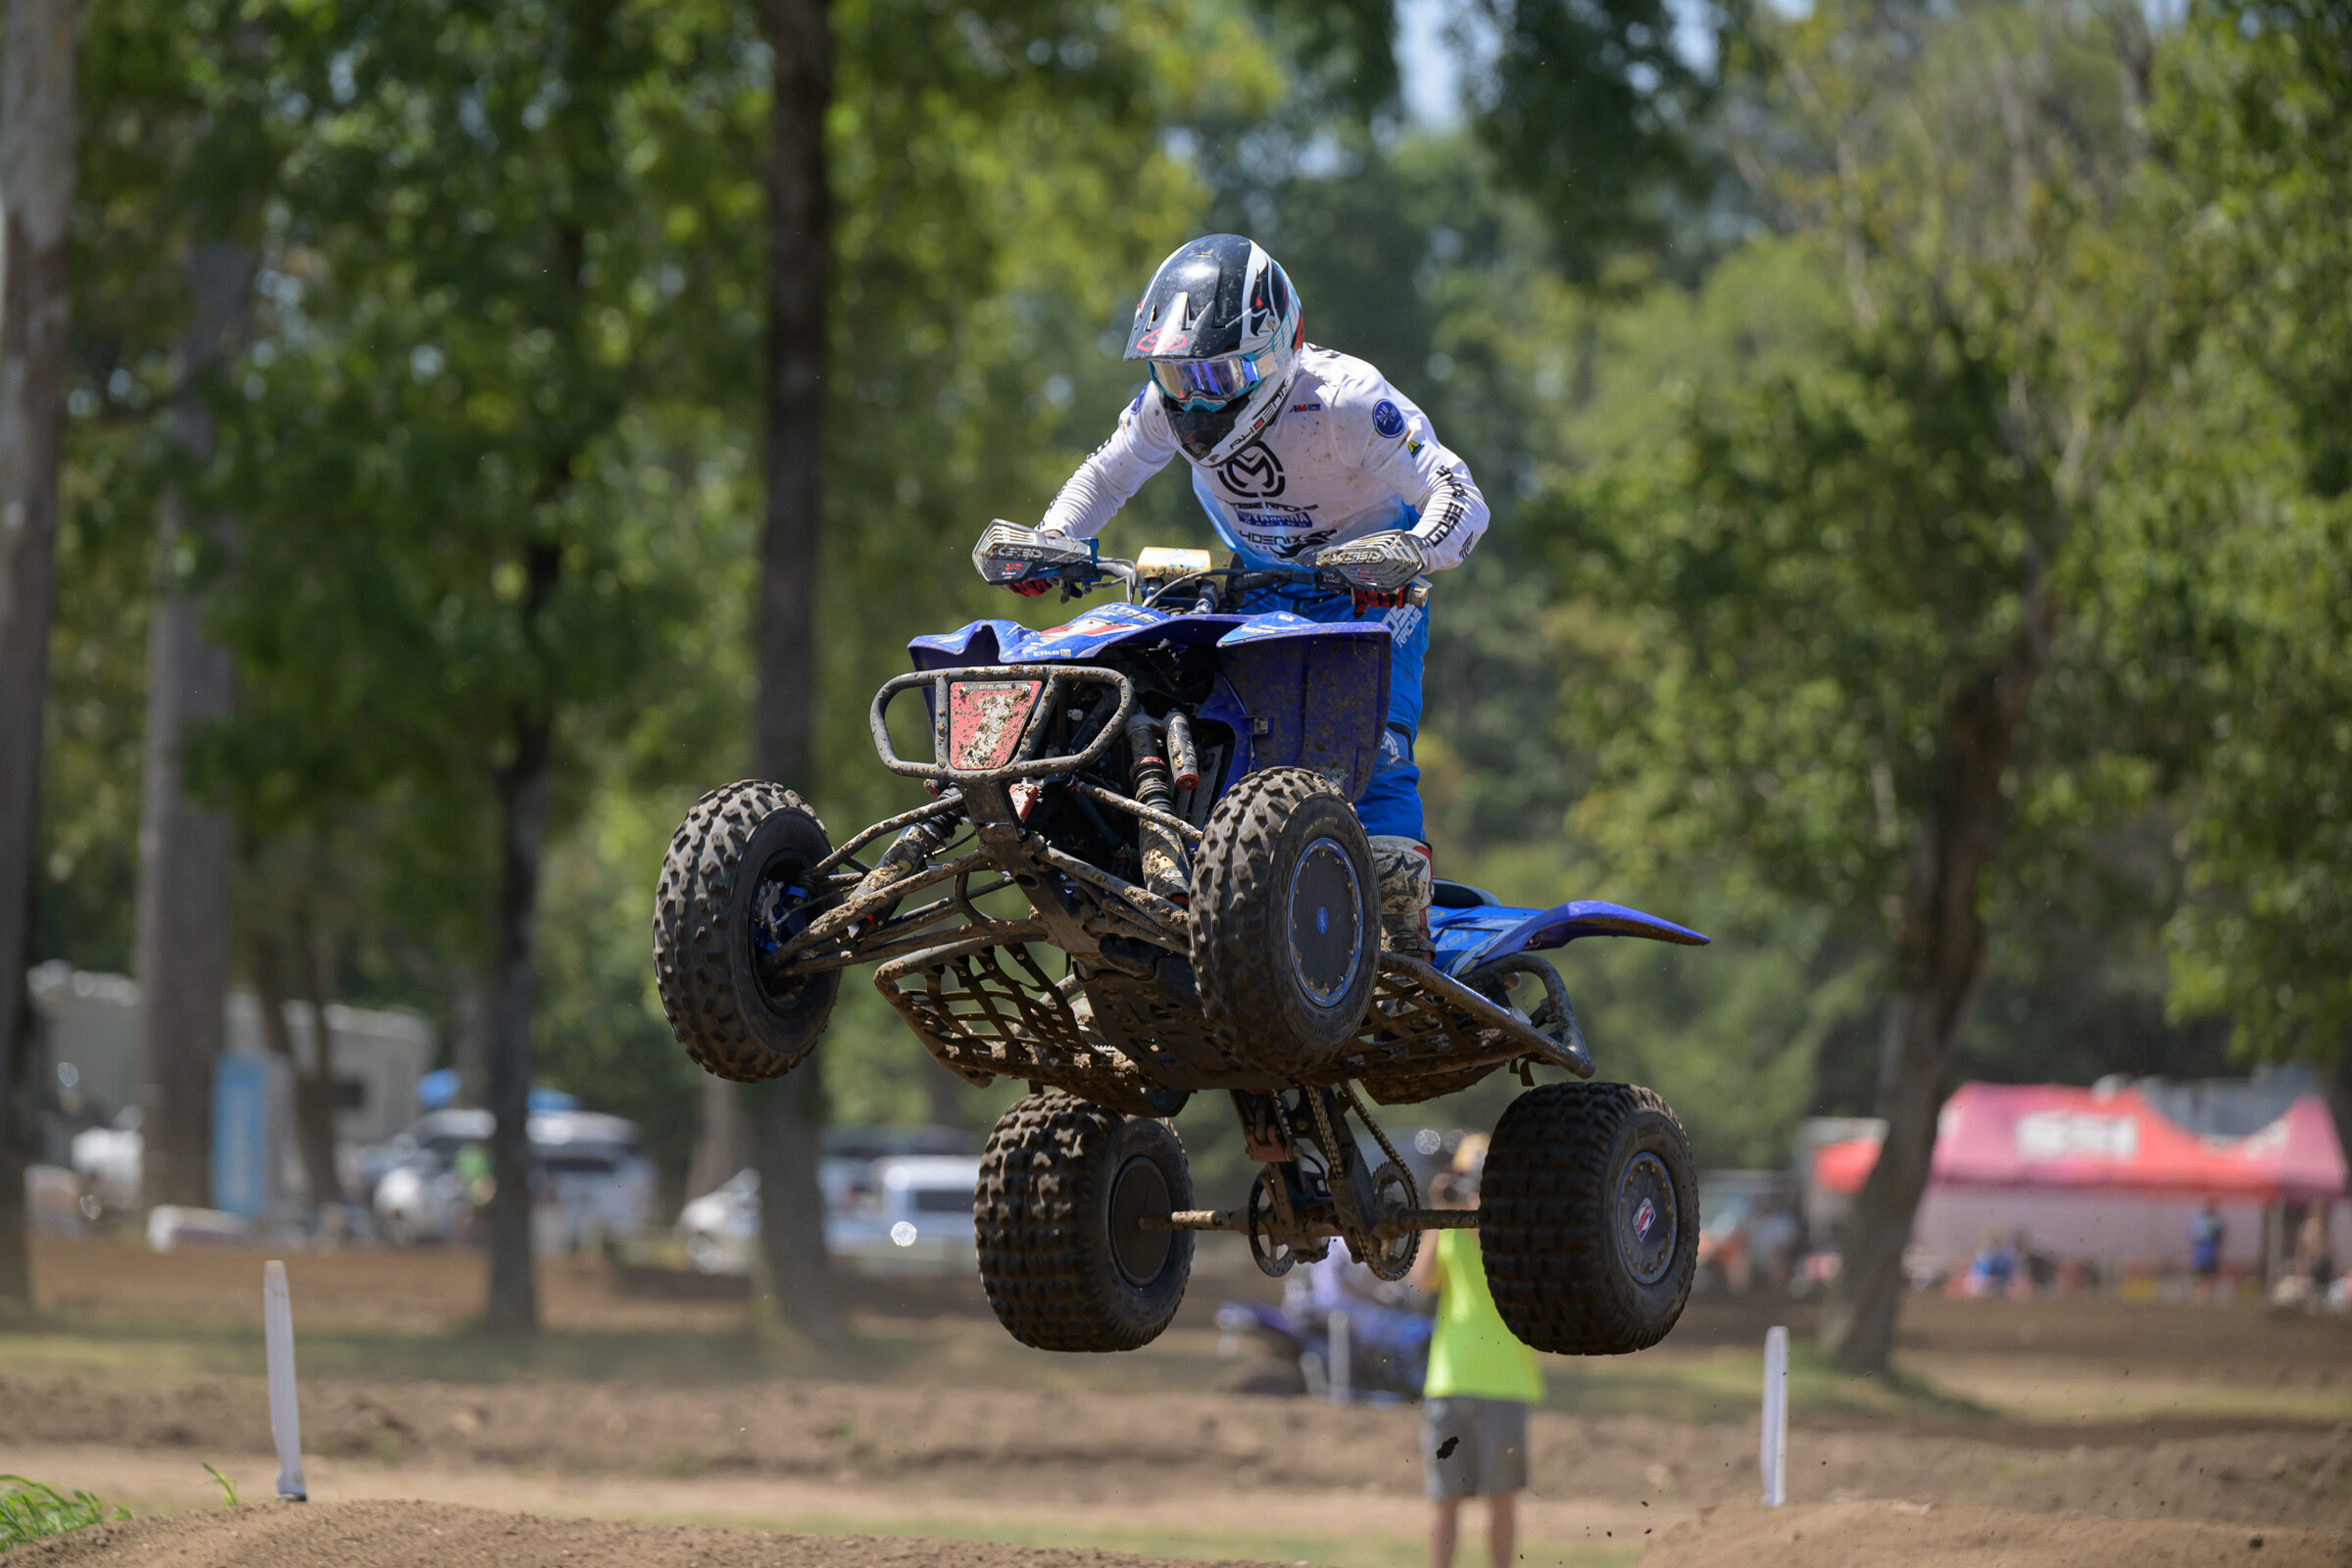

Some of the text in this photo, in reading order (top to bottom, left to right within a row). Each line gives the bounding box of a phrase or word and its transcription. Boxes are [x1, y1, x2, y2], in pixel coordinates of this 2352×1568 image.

[1424, 502, 1465, 548] OOSE
[1238, 530, 1302, 546] HOENIX
[987, 546, 1043, 559] CEBIS
